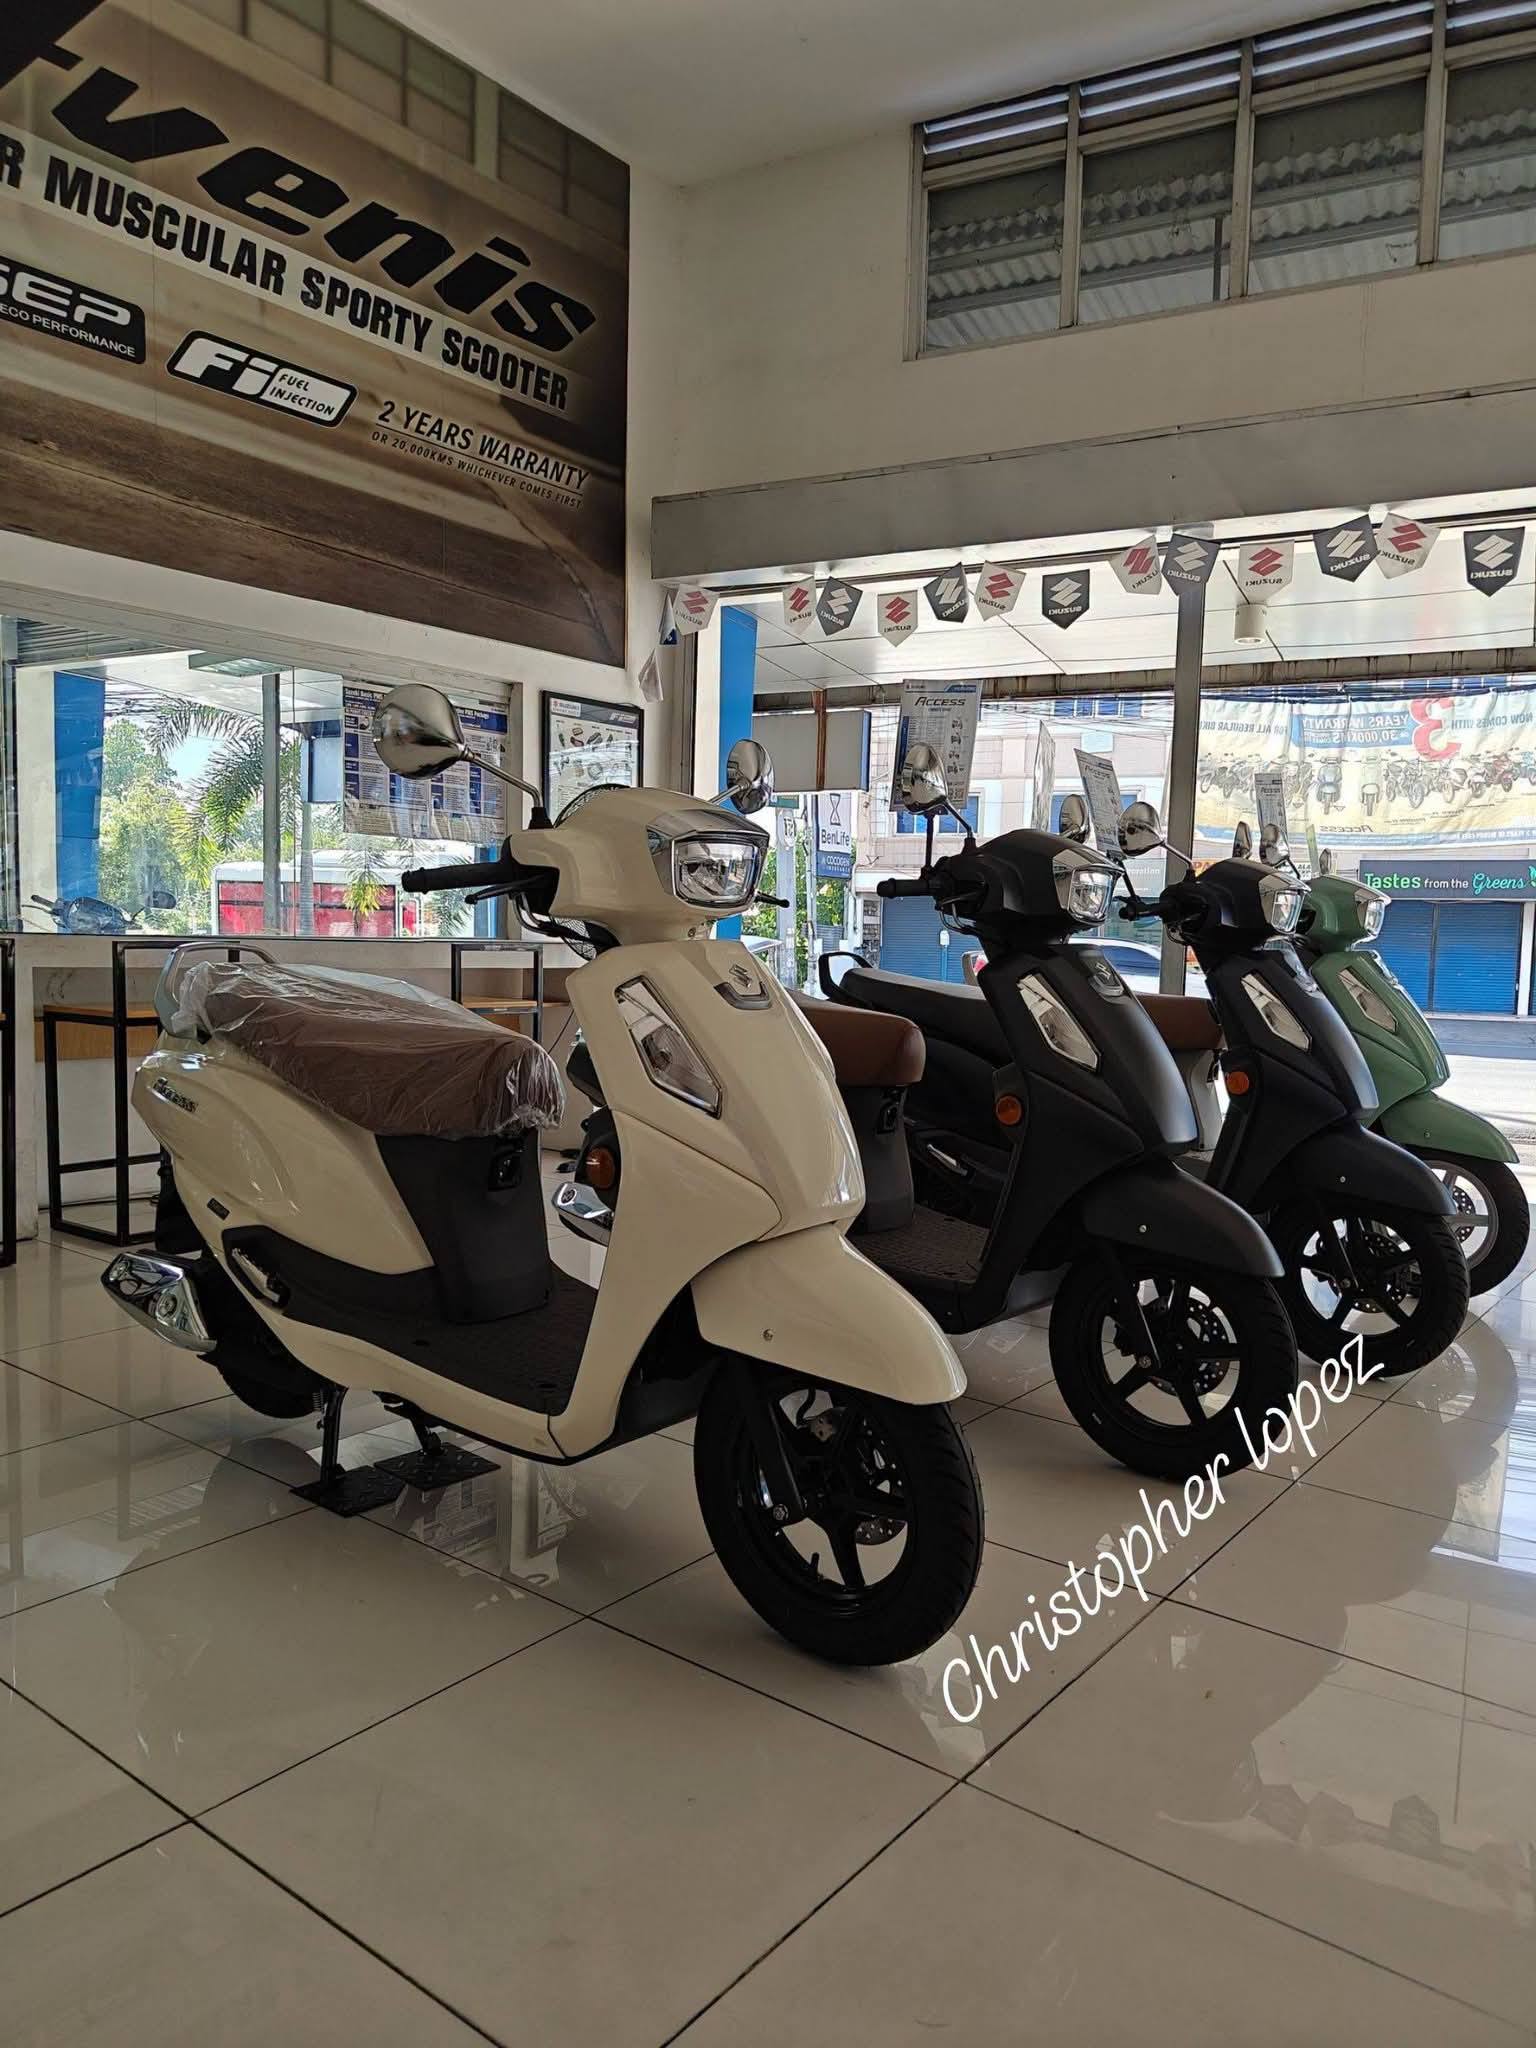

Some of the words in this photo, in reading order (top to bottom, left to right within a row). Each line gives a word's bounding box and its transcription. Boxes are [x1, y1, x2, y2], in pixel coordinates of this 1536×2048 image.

[0, 264, 131, 327] EP
[44, 155, 287, 296] MUSCULAR
[300, 267, 434, 353] SPORTY
[441, 327, 569, 411] SCOOTER
[32, 314, 136, 358] PERFORMANCE
[173, 337, 279, 397] Fi
[278, 374, 311, 392] FUEL
[269, 387, 336, 416] INJECTION
[371, 431, 388, 444] OR
[391, 438, 454, 467] 20,000KMS
[457, 459, 516, 488] WHICHEVER
[519, 480, 553, 501] COMES
[555, 493, 583, 510] FIRST
[378, 400, 396, 423] 2
[402, 406, 475, 451] YEARS
[479, 434, 590, 490] WARRANTY
[821, 829, 850, 847] BenLife
[1365, 873, 1421, 888] Tastes
[1424, 878, 1449, 888] from
[1451, 878, 1469, 888] the
[1473, 873, 1526, 895] Greens
